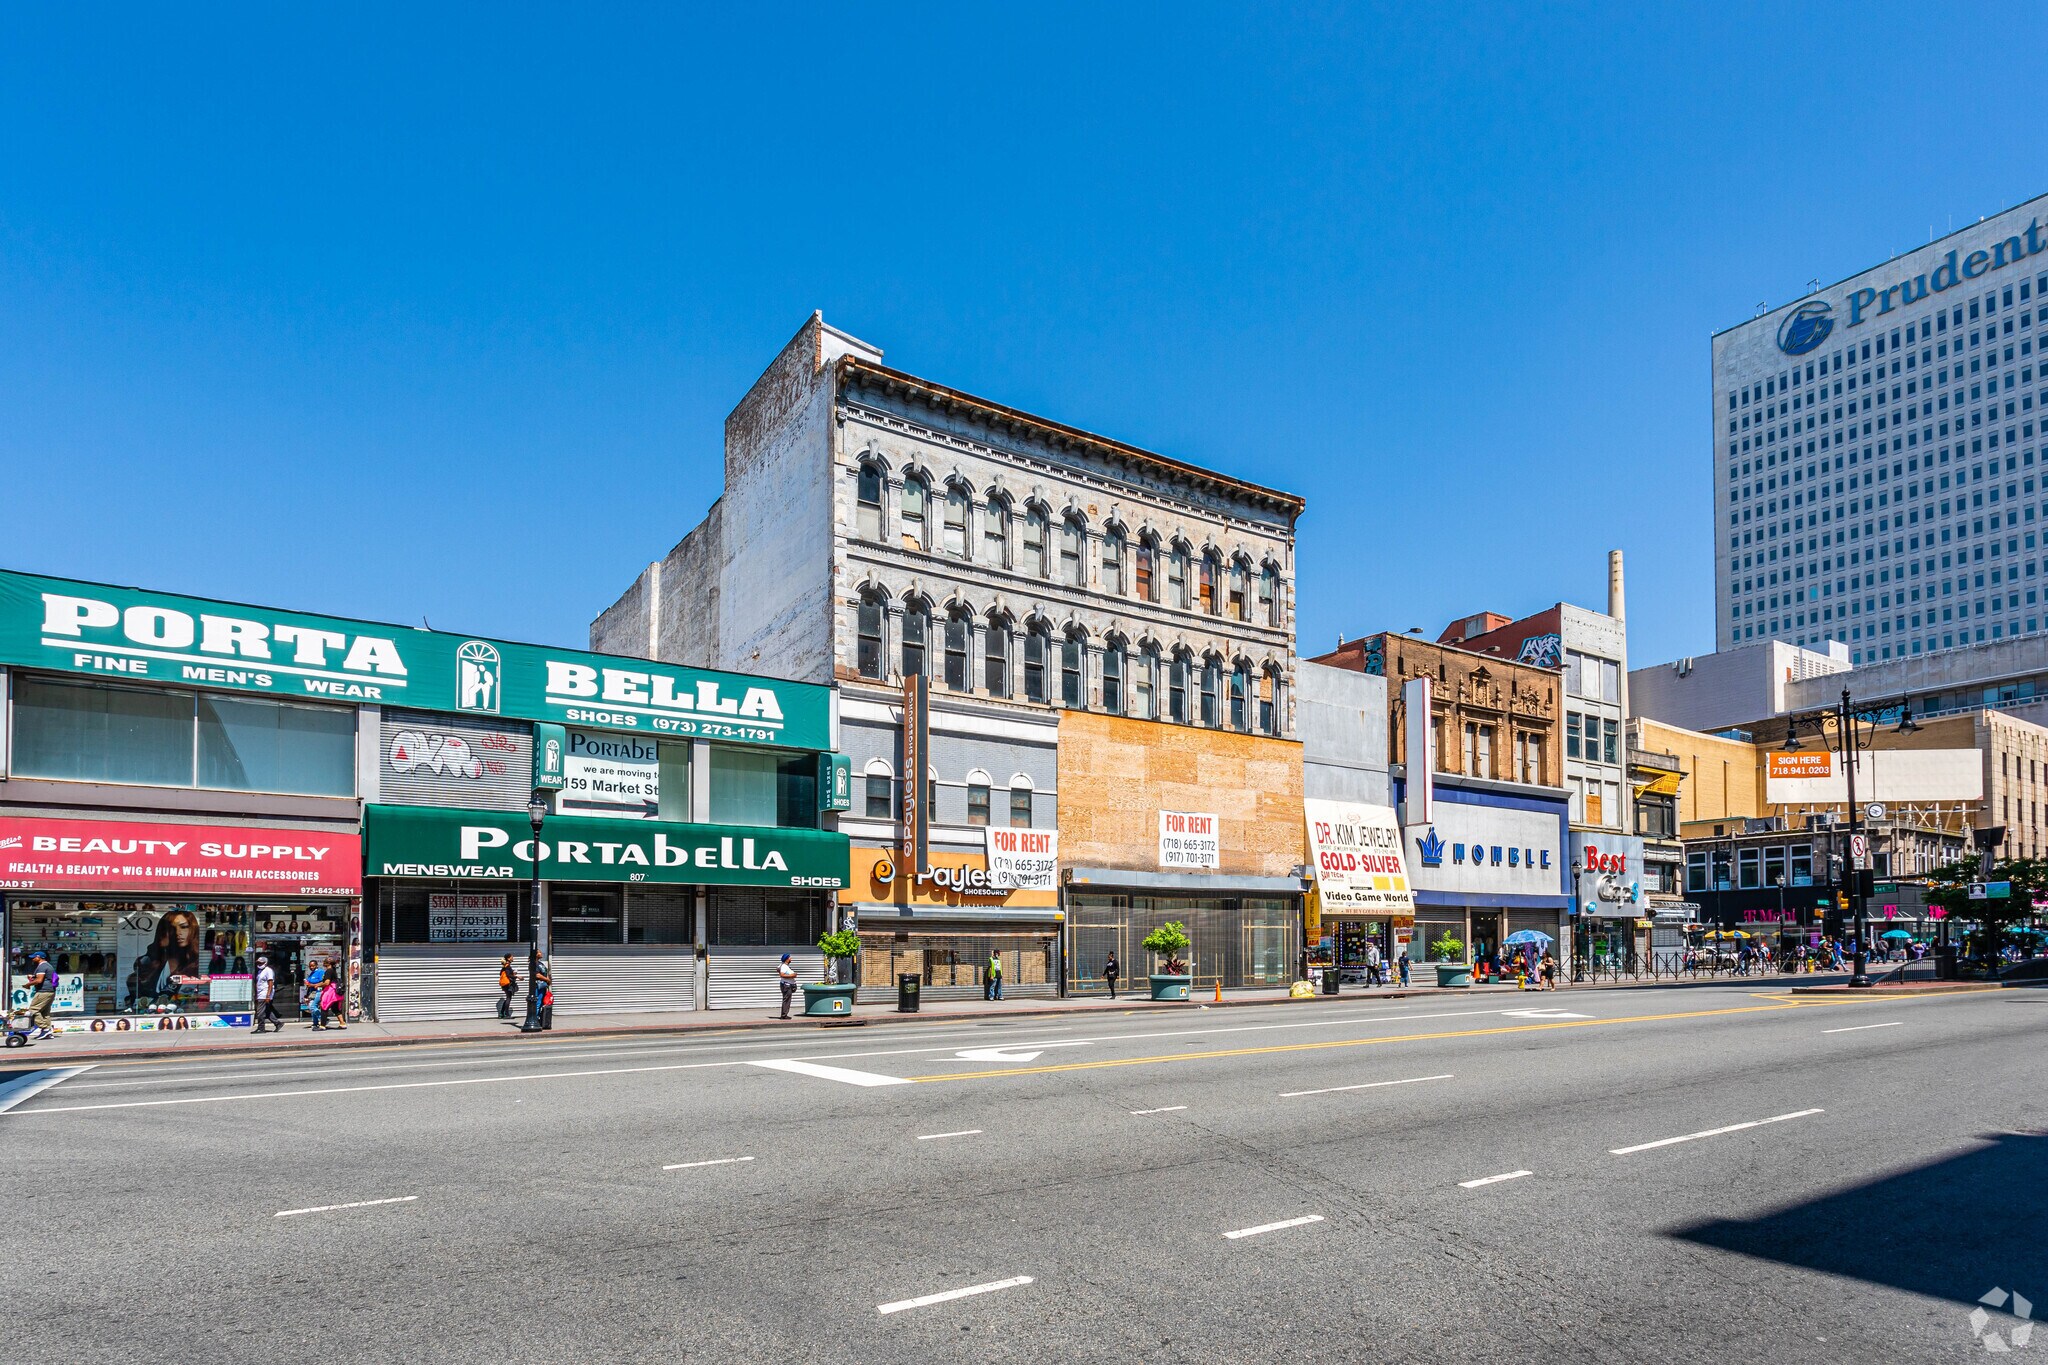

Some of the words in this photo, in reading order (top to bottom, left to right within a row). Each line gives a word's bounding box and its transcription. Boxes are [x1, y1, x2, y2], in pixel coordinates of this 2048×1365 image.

[41, 593, 408, 675] PORTA
[74, 654, 148, 674] FINE
[182, 666, 273, 687] MEN'S
[303, 680, 382, 700] WEAR
[546, 660, 784, 720] BELLA
[566, 709, 638, 726] SHOES
[652, 717, 697, 733] (973)
[701, 723, 775, 740] 273-1791
[1778, 757, 1798, 765] SIGN
[1799, 756, 1822, 764] HERE
[583, 766, 597, 774] we
[617, 769, 652, 780] moving
[1772, 766, 1830, 775] 718.941.0203
[540, 774, 563, 785] WEAR
[563, 777, 588, 790] 159
[592, 780, 640, 795] Market
[644, 784, 659, 795] St
[833, 798, 850, 807] SHOES
[1166, 814, 1185, 833] FOR
[1188, 816, 1212, 835] RENT
[1315, 822, 1335, 844] DR.
[1335, 824, 1356, 846] KIM
[1358, 826, 1398, 848] JEWELRY
[33, 836, 187, 855] BEAUTY
[200, 842, 331, 860] SUPPLY
[994, 831, 1017, 852] FOR
[1021, 833, 1051, 853] RENT
[1163, 838, 1182, 850] (718)
[1183, 839, 1216, 851] 665-3172
[1165, 851, 1184, 864] (917)
[1186, 852, 1214, 864] 701-3171
[1320, 852, 1357, 871] GOLD
[1361, 854, 1402, 874] SILVER
[1585, 845, 1627, 873] Best
[9, 862, 53, 874] HEALTH
[56, 864, 64, 874] &
[66, 864, 110, 875] BEAUTY
[122, 866, 143, 876] WIG
[145, 867, 152, 876] &
[155, 867, 192, 877] HUMAN
[194, 868, 218, 878] HAIR
[229, 870, 253, 879] HAIR
[255, 871, 319, 881] ACCESSORIES
[383, 863, 513, 878] MENSWEAR
[1015, 859, 1053, 872] 665-3172
[21, 880, 35, 888] ST
[629, 873, 645, 882] 807
[790, 876, 841, 887] SHOES
[301, 887, 354, 895] 973-642-4581
[964, 888, 1008, 896] SHOESOURCE
[1325, 891, 1353, 901] Video
[1355, 892, 1382, 902] Game
[1384, 893, 1409, 902] World
[462, 896, 479, 908] FOR
[482, 896, 504, 908] RENT
[121, 917, 154, 932] XQ
[461, 916, 504, 926] 701-3171
[460, 928, 505, 938] 665-3172
